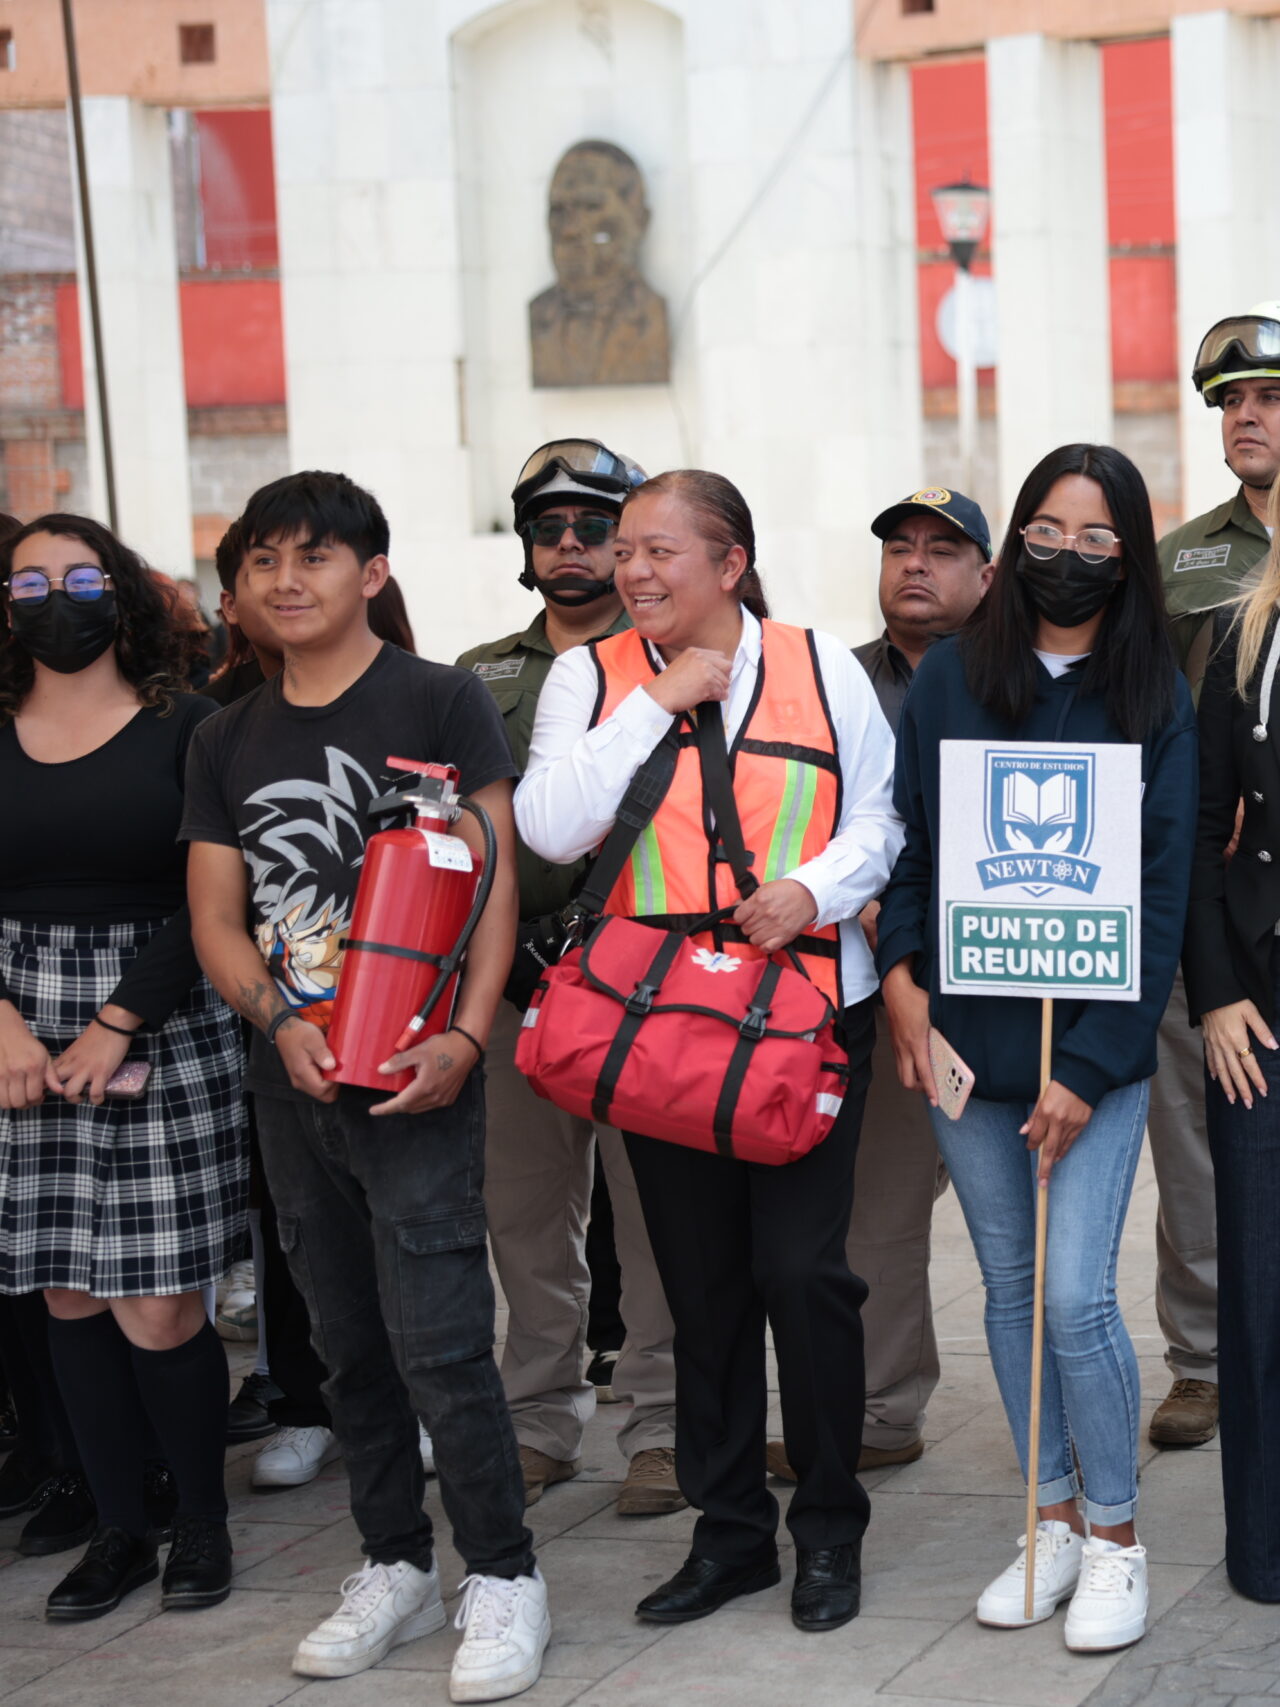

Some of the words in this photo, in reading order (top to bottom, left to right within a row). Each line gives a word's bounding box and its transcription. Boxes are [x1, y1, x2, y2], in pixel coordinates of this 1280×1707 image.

[993, 760, 1029, 769] CENTRO
[1030, 761, 1042, 769] DE
[1043, 762, 1085, 771] ESTUDIOS
[962, 915, 1065, 942] PUNTO
[1076, 919, 1118, 943] DE
[960, 946, 1120, 978] REUNION
